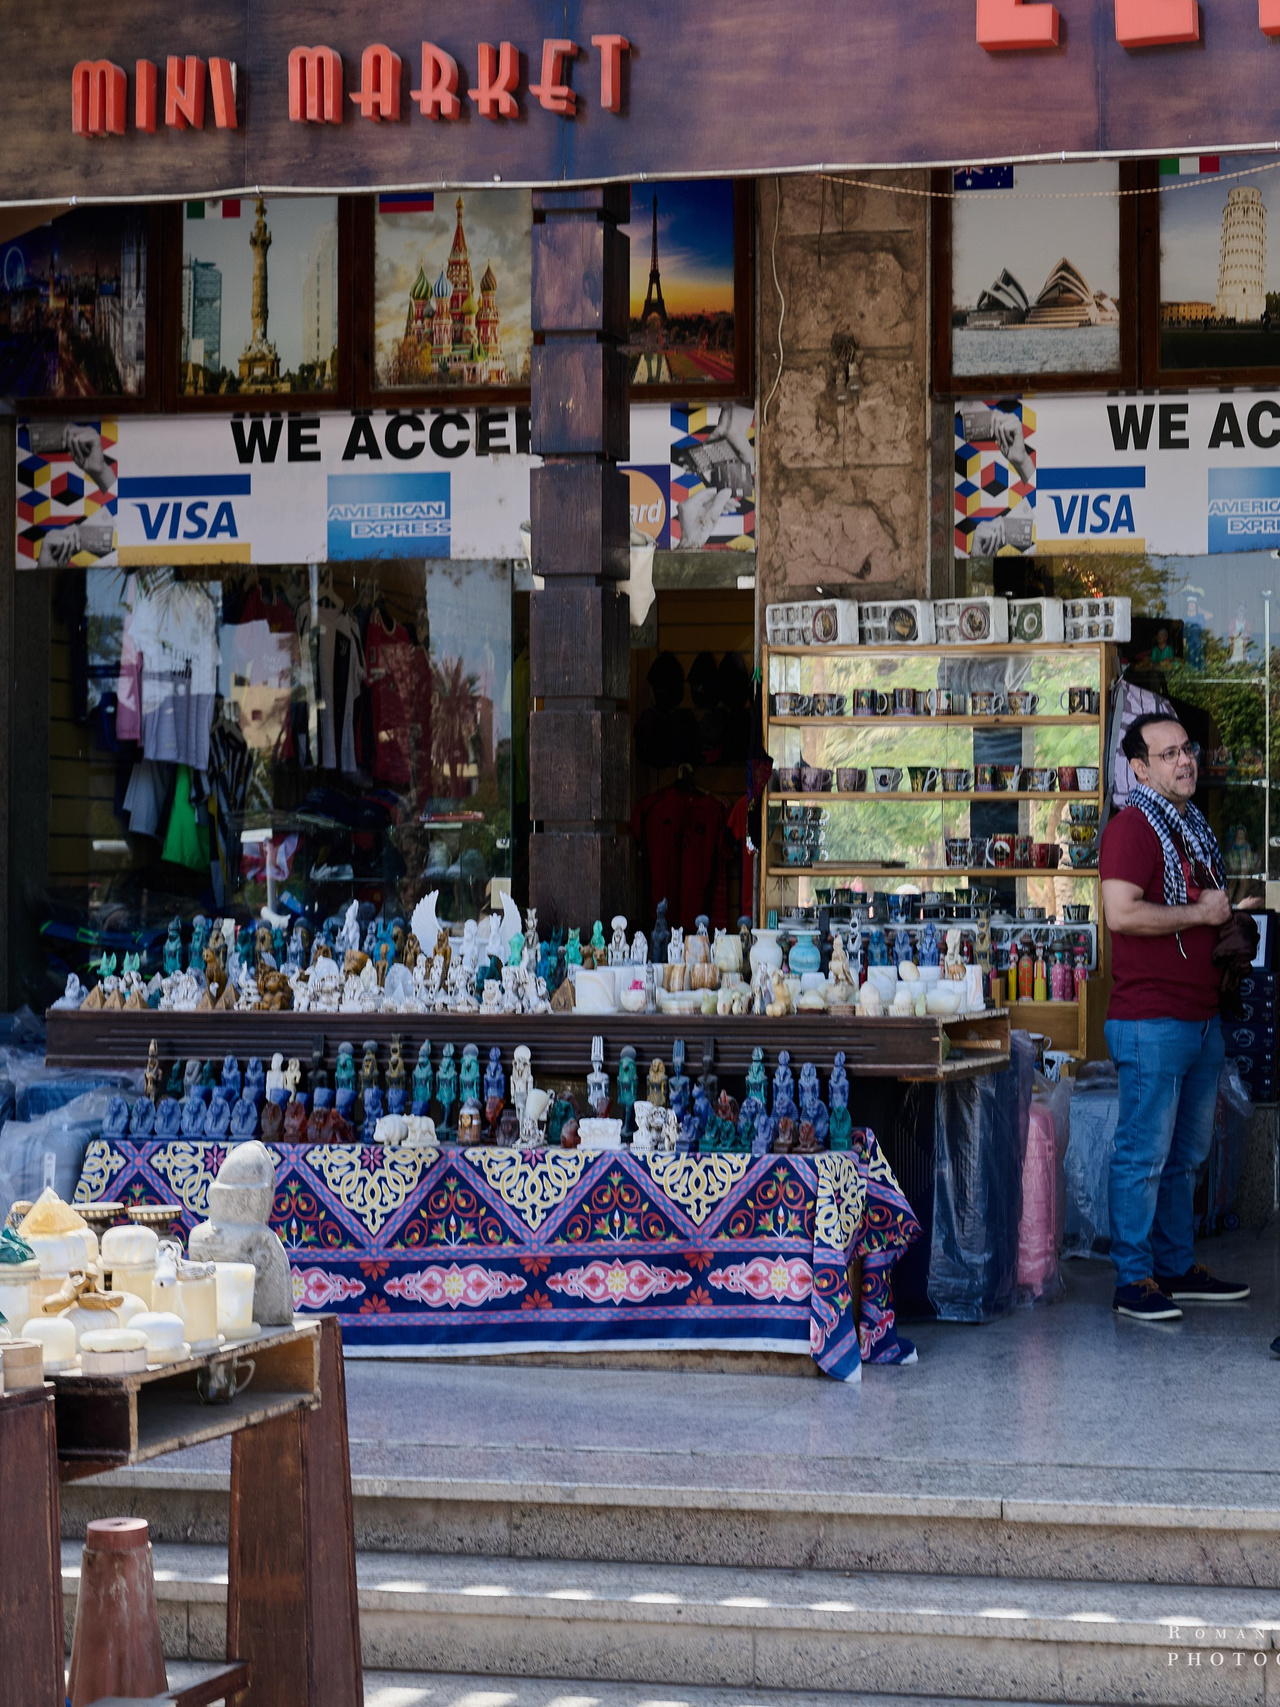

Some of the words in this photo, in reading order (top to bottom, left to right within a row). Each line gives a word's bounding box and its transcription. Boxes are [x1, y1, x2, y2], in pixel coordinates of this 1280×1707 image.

[72, 56, 238, 137] MINI
[288, 34, 632, 123] MARKET
[231, 415, 321, 464] WE
[1106, 404, 1190, 450] WE
[134, 502, 239, 541] VISA
[328, 502, 445, 520] AMERICAN
[351, 519, 451, 538] EXPRESS
[1050, 494, 1136, 534] VISA
